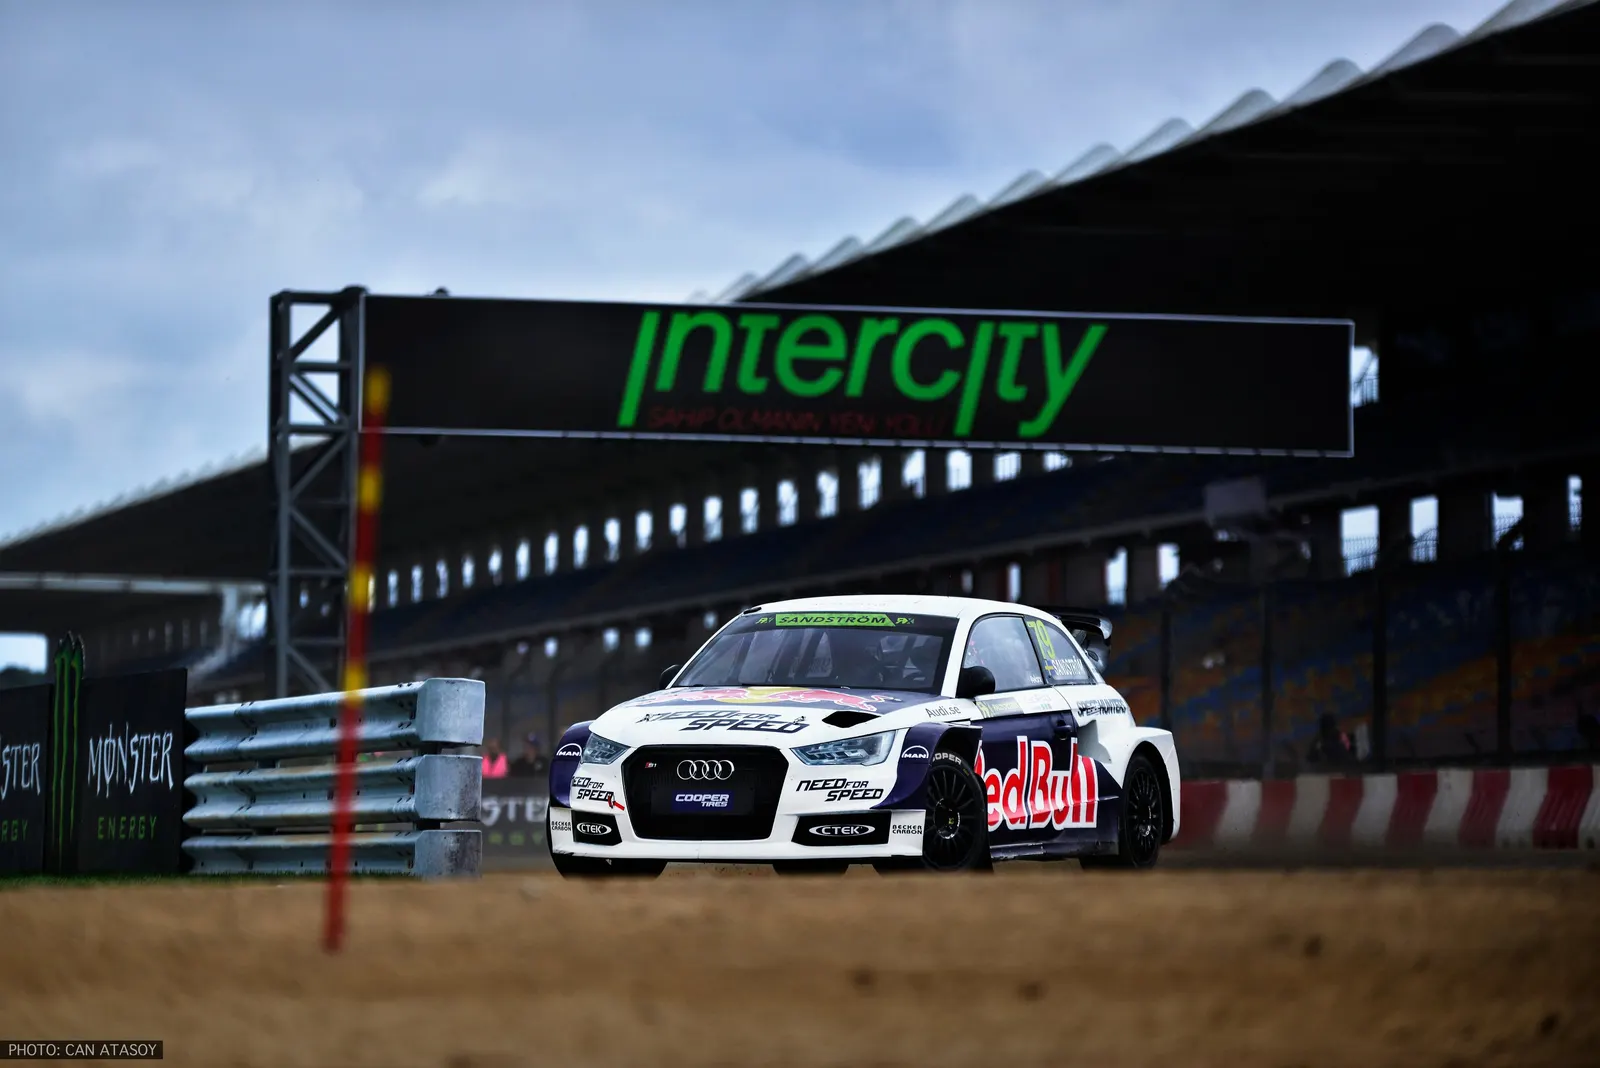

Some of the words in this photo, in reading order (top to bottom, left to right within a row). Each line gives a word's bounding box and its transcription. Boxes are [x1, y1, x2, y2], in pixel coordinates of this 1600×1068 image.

[779, 615, 887, 625] SANDSTRÖM
[1026, 620, 1057, 659] 79
[925, 705, 962, 718] Audi.se
[679, 719, 811, 734] SPEED
[0, 742, 41, 800] STER
[796, 778, 847, 791] NEED
[844, 781, 869, 789] FOR
[1029, 737, 1099, 831] Bull
[675, 794, 730, 802] COOPER
[824, 789, 884, 802] SPEED
[0, 819, 28, 842] RGY
[97, 815, 157, 840] ENERGY
[581, 824, 603, 834] CTEK
[821, 826, 860, 835] CTEK
